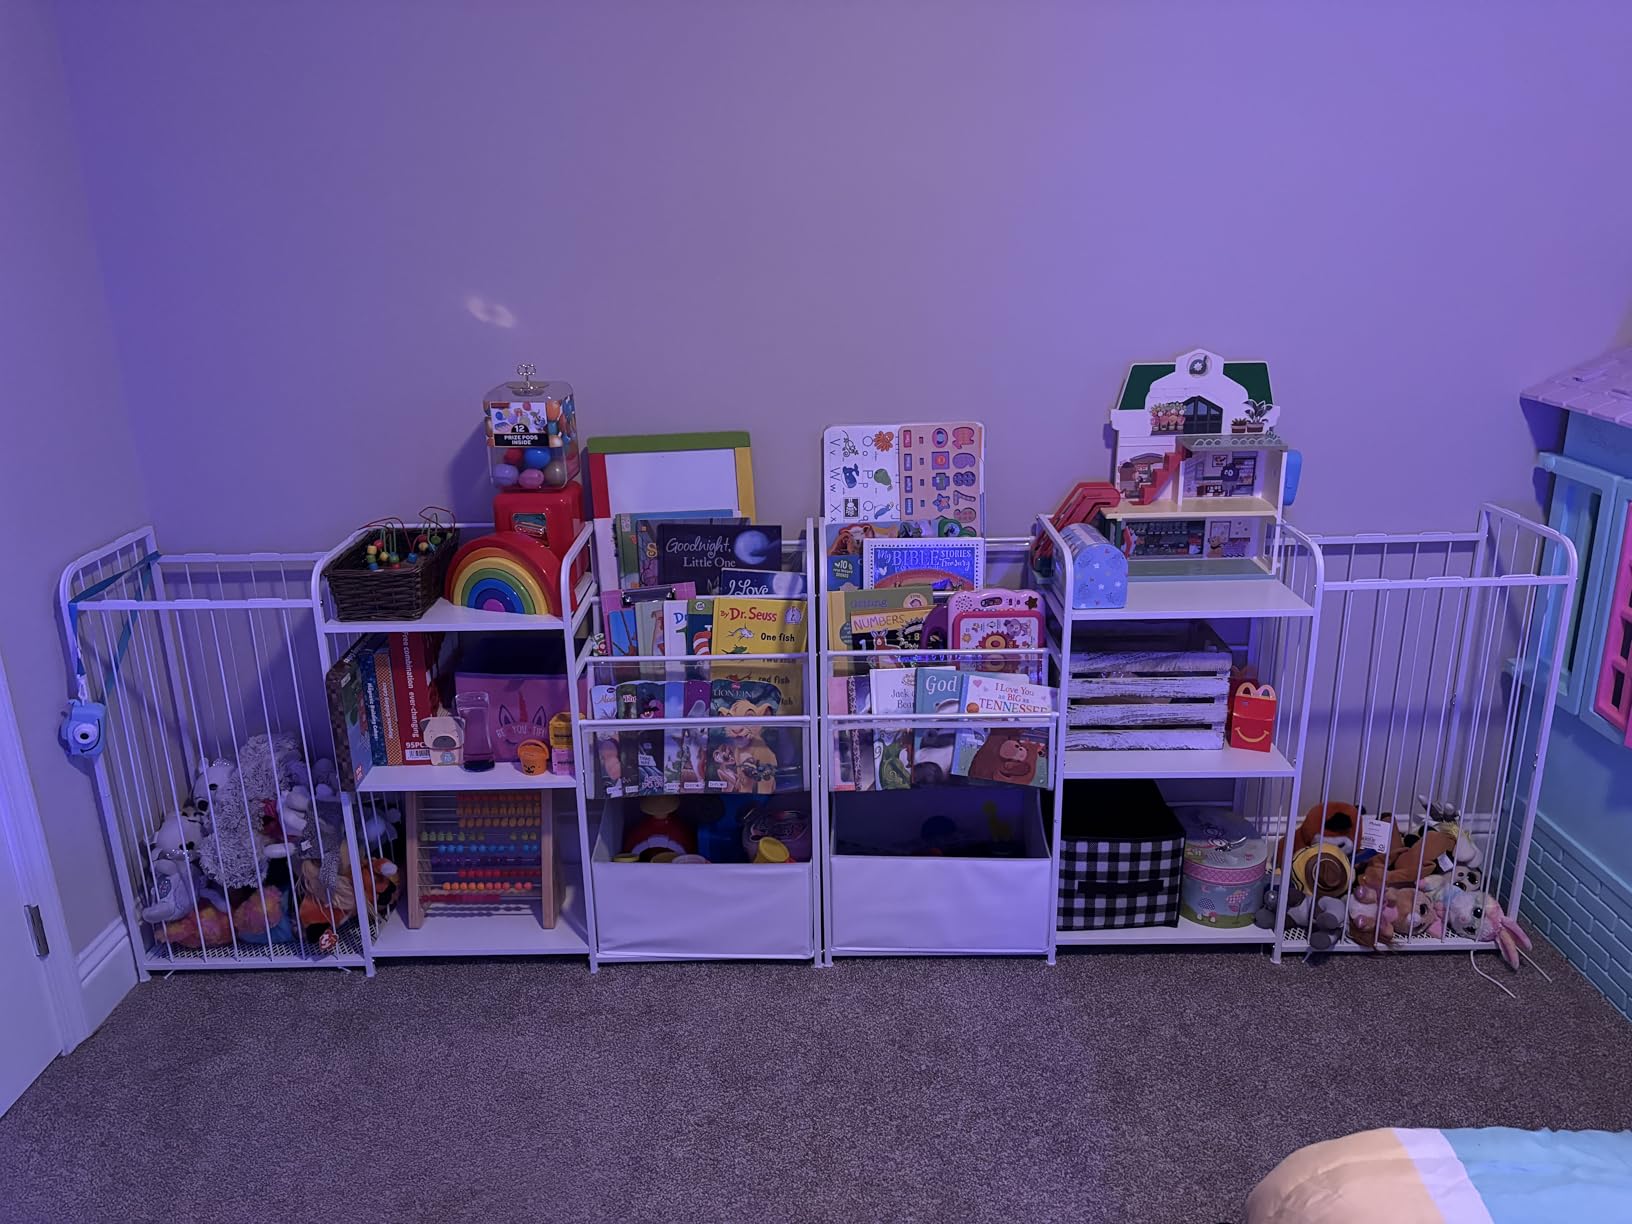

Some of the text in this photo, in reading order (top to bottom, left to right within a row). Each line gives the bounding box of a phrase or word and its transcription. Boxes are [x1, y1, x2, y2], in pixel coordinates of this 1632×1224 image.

[830, 467, 841, 481] W
[830, 504, 841, 513] X
[683, 557, 736, 568] Little One
[892, 549, 940, 566] BIBLE
[941, 549, 971, 558] STORIES
[738, 580, 768, 595] Love
[720, 607, 777, 622] By Dr. Seuss
[853, 614, 905, 631] NUMBERS
[760, 632, 795, 642] One fish
[774, 675, 790, 684] fish
[926, 674, 957, 695] God
[403, 646, 415, 689] combination
[409, 691, 420, 739] ever-changing
[890, 689, 909, 699] Jack
[995, 683, 1034, 697] I Love You
[1007, 693, 1021, 702] BIG
[511, 724, 527, 735] YOU
